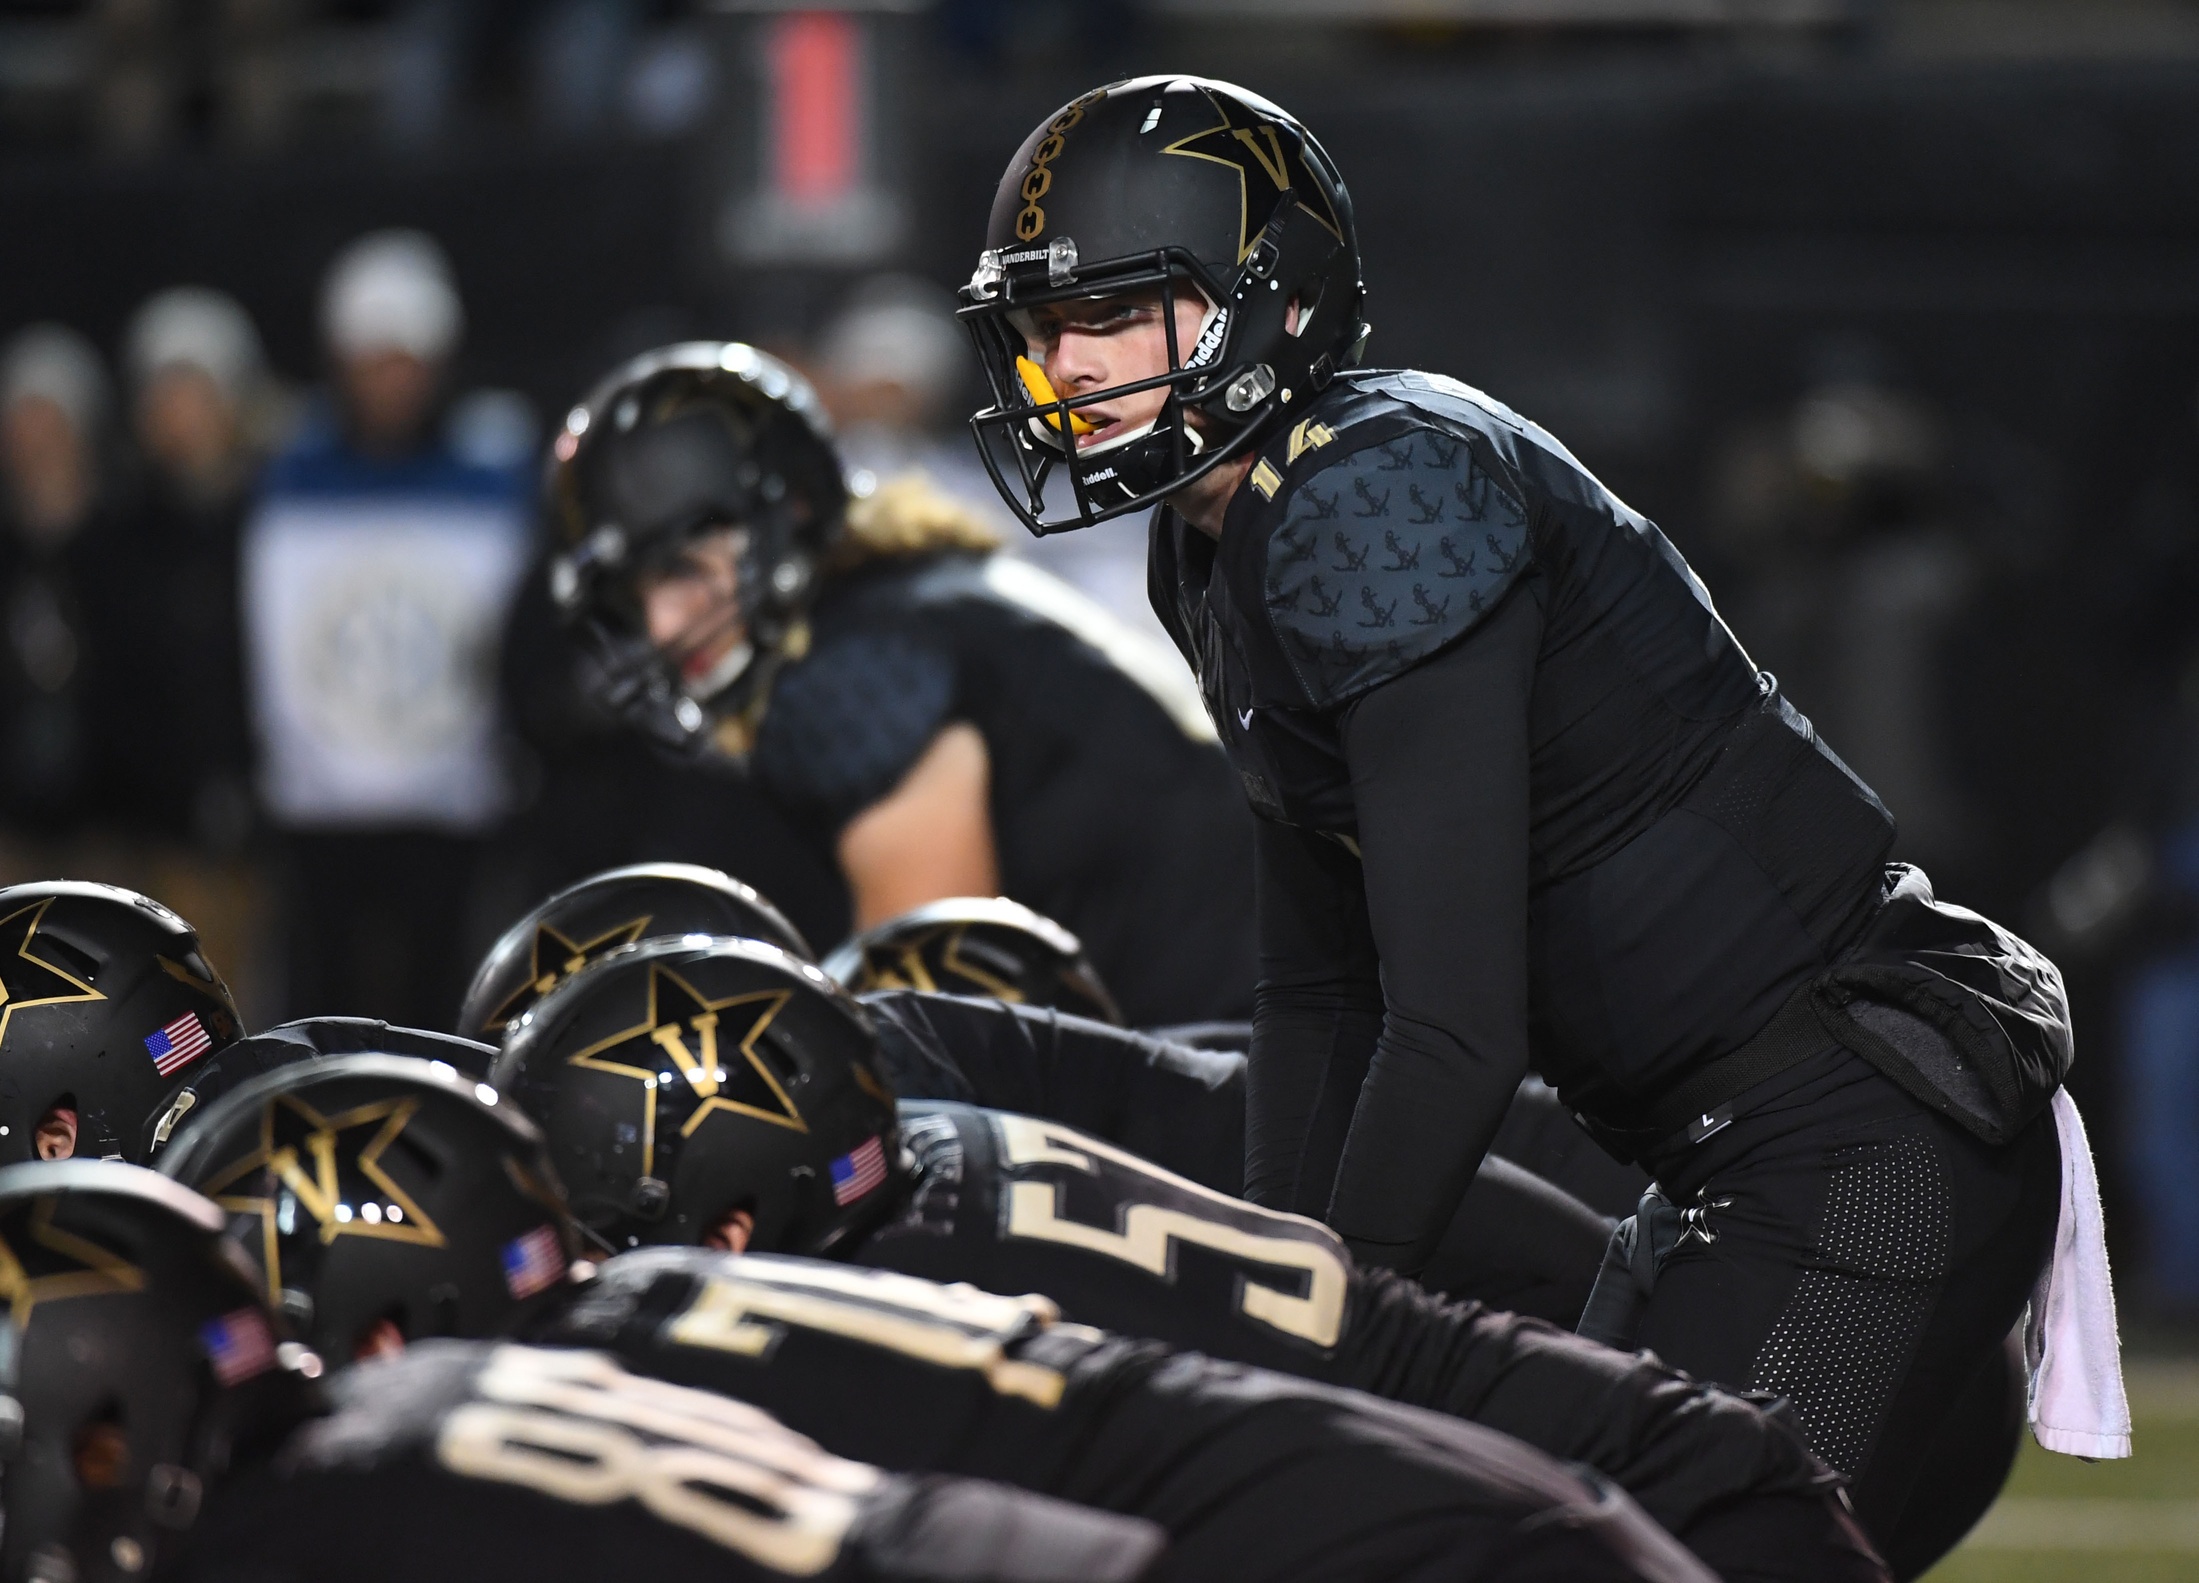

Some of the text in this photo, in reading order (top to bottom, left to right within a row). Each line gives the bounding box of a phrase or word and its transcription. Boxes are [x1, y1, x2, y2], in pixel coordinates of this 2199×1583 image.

[1231, 125, 1291, 191] V
[1002, 249, 1049, 265] VANDERBILT
[1250, 416, 1338, 502] 14
[651, 1011, 719, 1098] V
[270, 1130, 340, 1223] V
